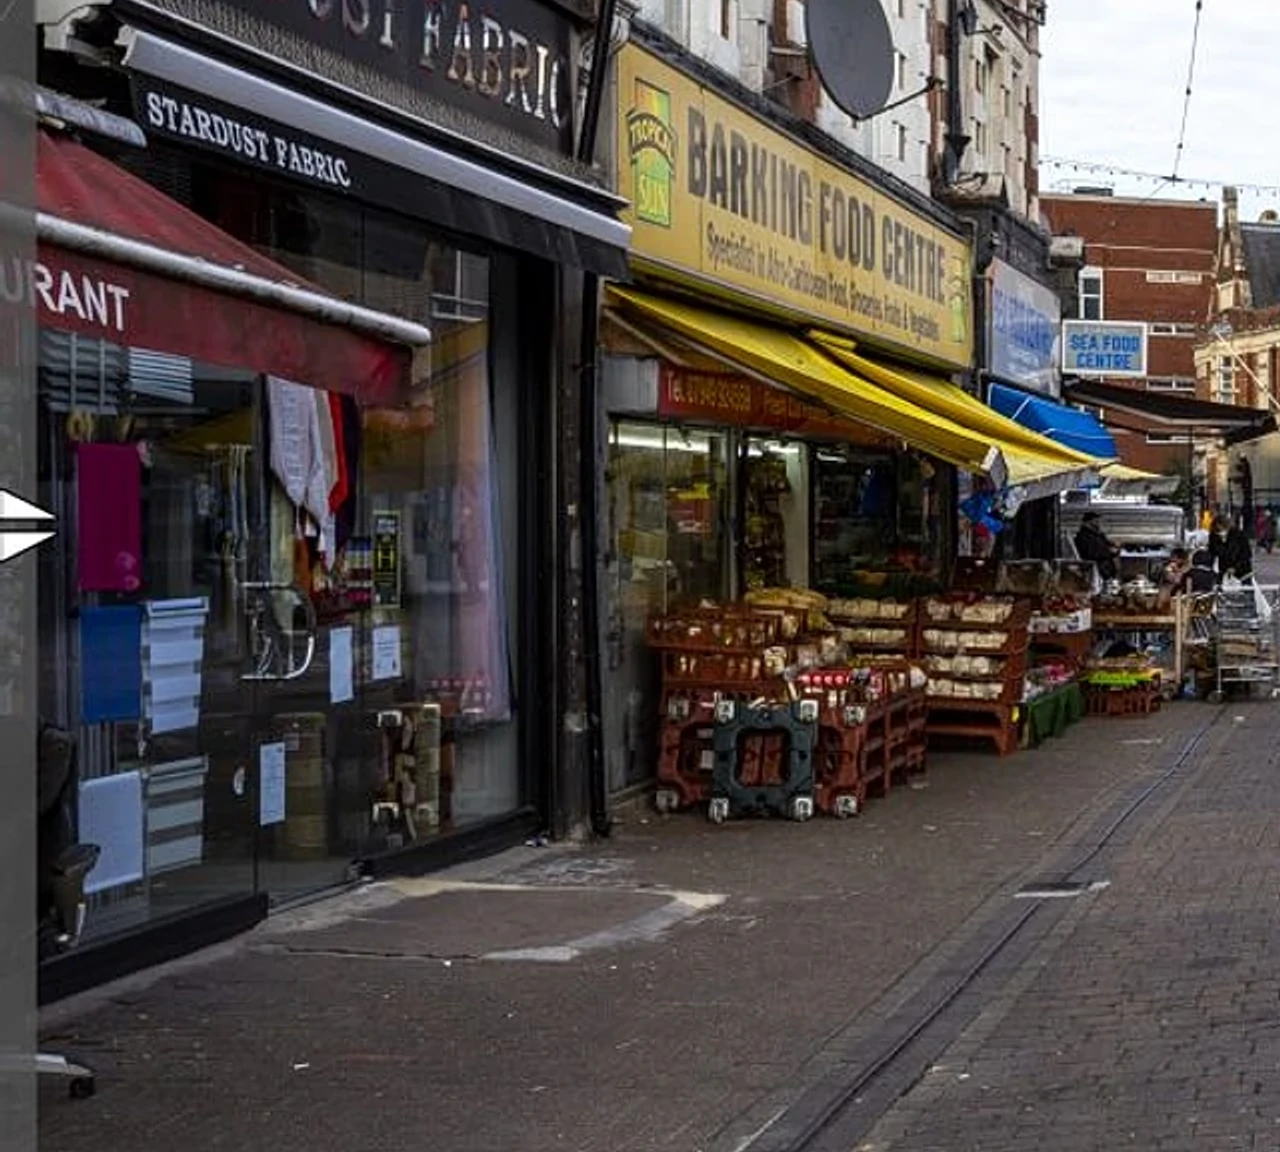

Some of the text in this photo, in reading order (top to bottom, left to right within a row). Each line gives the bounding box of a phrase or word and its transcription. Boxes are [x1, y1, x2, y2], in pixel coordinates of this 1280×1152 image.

[146, 90, 352, 189] STARDUST FABRIC
[687, 107, 813, 246] BARKING
[820, 180, 876, 272] FOOD
[882, 214, 945, 306] CENTRE
[1070, 332, 1141, 352] SEA FOOD
[1076, 353, 1134, 369] CENTRE
